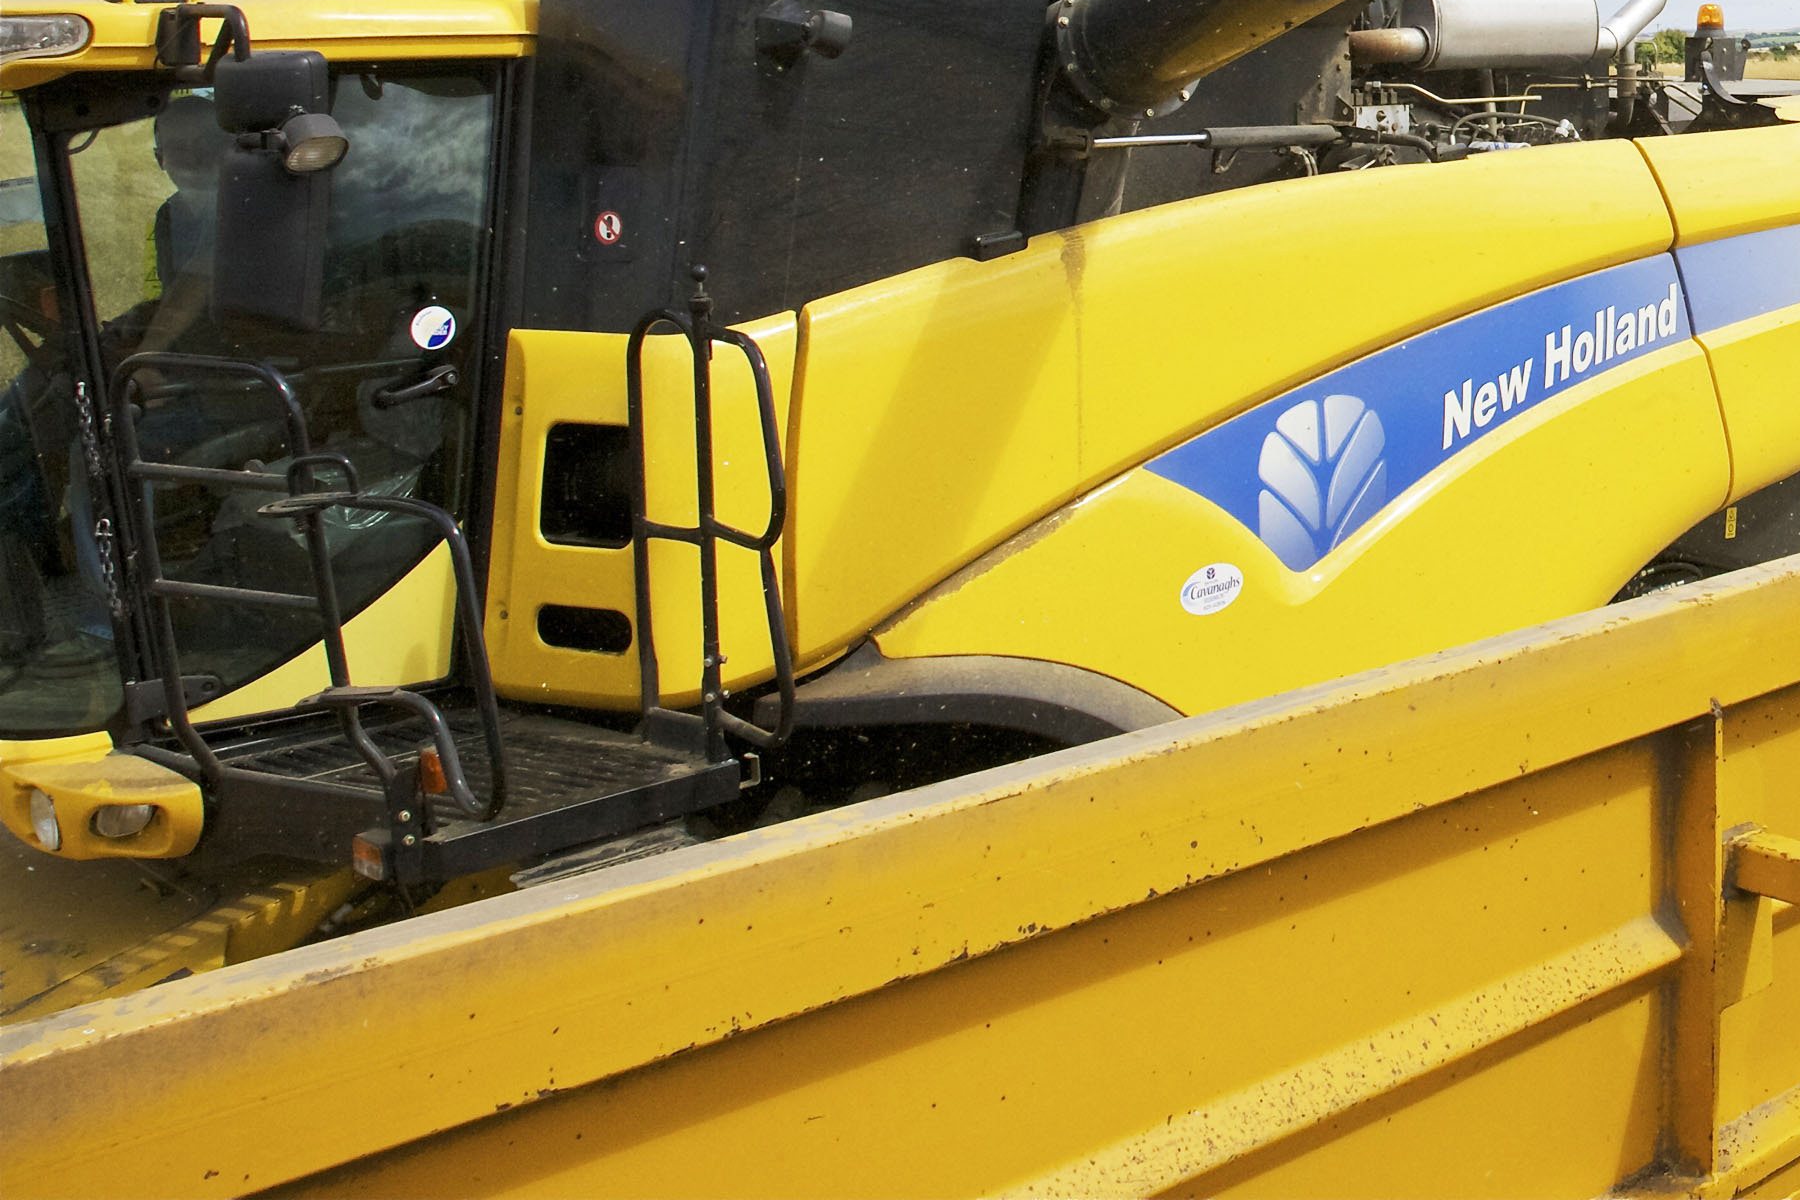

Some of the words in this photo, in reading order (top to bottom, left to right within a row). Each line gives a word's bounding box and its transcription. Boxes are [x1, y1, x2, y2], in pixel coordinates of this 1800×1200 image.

[1441, 357, 1533, 451] New
[1544, 282, 1678, 390] Holland
[1190, 575, 1240, 600] Cavanaghs
